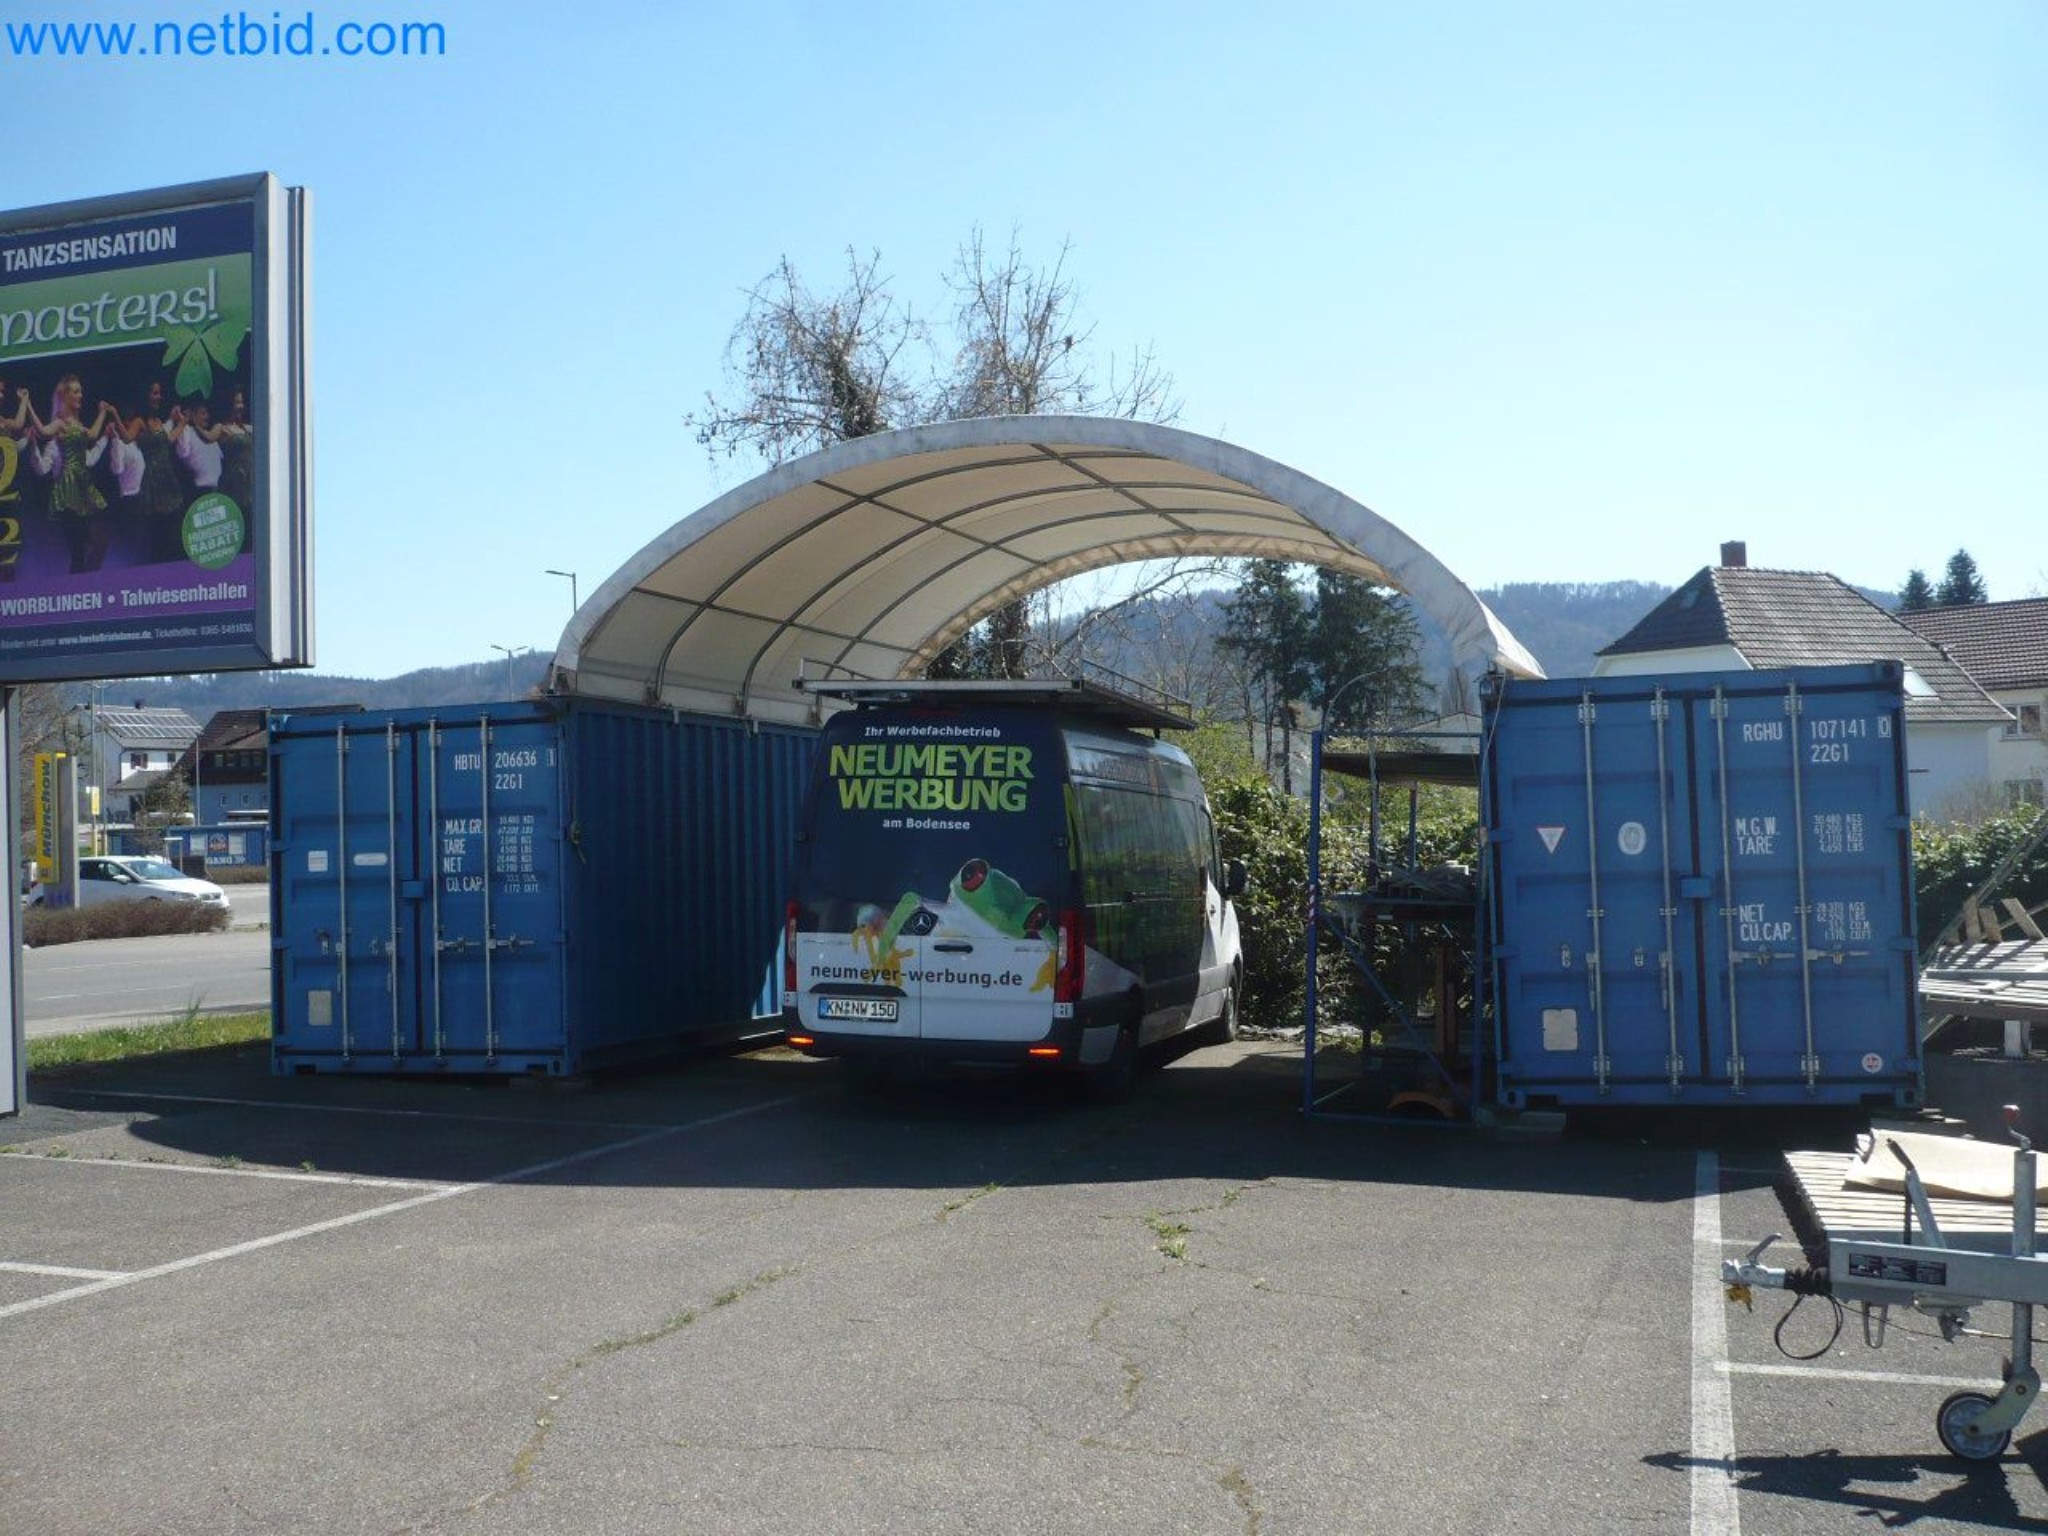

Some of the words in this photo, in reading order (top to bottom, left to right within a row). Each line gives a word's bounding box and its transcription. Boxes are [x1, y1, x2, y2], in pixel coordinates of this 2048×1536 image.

[3, 226, 178, 272] TANZSENSATION
[121, 582, 248, 608] Talwiesenhallen
[864, 726, 884, 737] Ihr
[887, 725, 1001, 738] Werbefachbetrieb
[1742, 723, 1783, 742] RGHU
[1810, 718, 1867, 739] 107141
[454, 754, 481, 770] HBTU
[495, 750, 537, 768] 206636
[829, 744, 1034, 778] NEUMEYER
[1810, 743, 1850, 763] 22G1
[495, 773, 523, 789] 22G1
[838, 778, 1028, 812] WERBUNG
[882, 819, 902, 829] am
[906, 818, 971, 830] Bodensee
[1735, 817, 1780, 836] M.G.W.
[443, 838, 466, 854] TARE
[1737, 836, 1775, 855] TARE
[443, 856, 463, 873] NET
[1738, 904, 1765, 922] NET
[1740, 922, 1796, 941] CU.CAP.
[810, 965, 1023, 988] neumeyer-werbung.de
[850, 1000, 868, 1015] NW
[870, 1003, 895, 1018] 150
